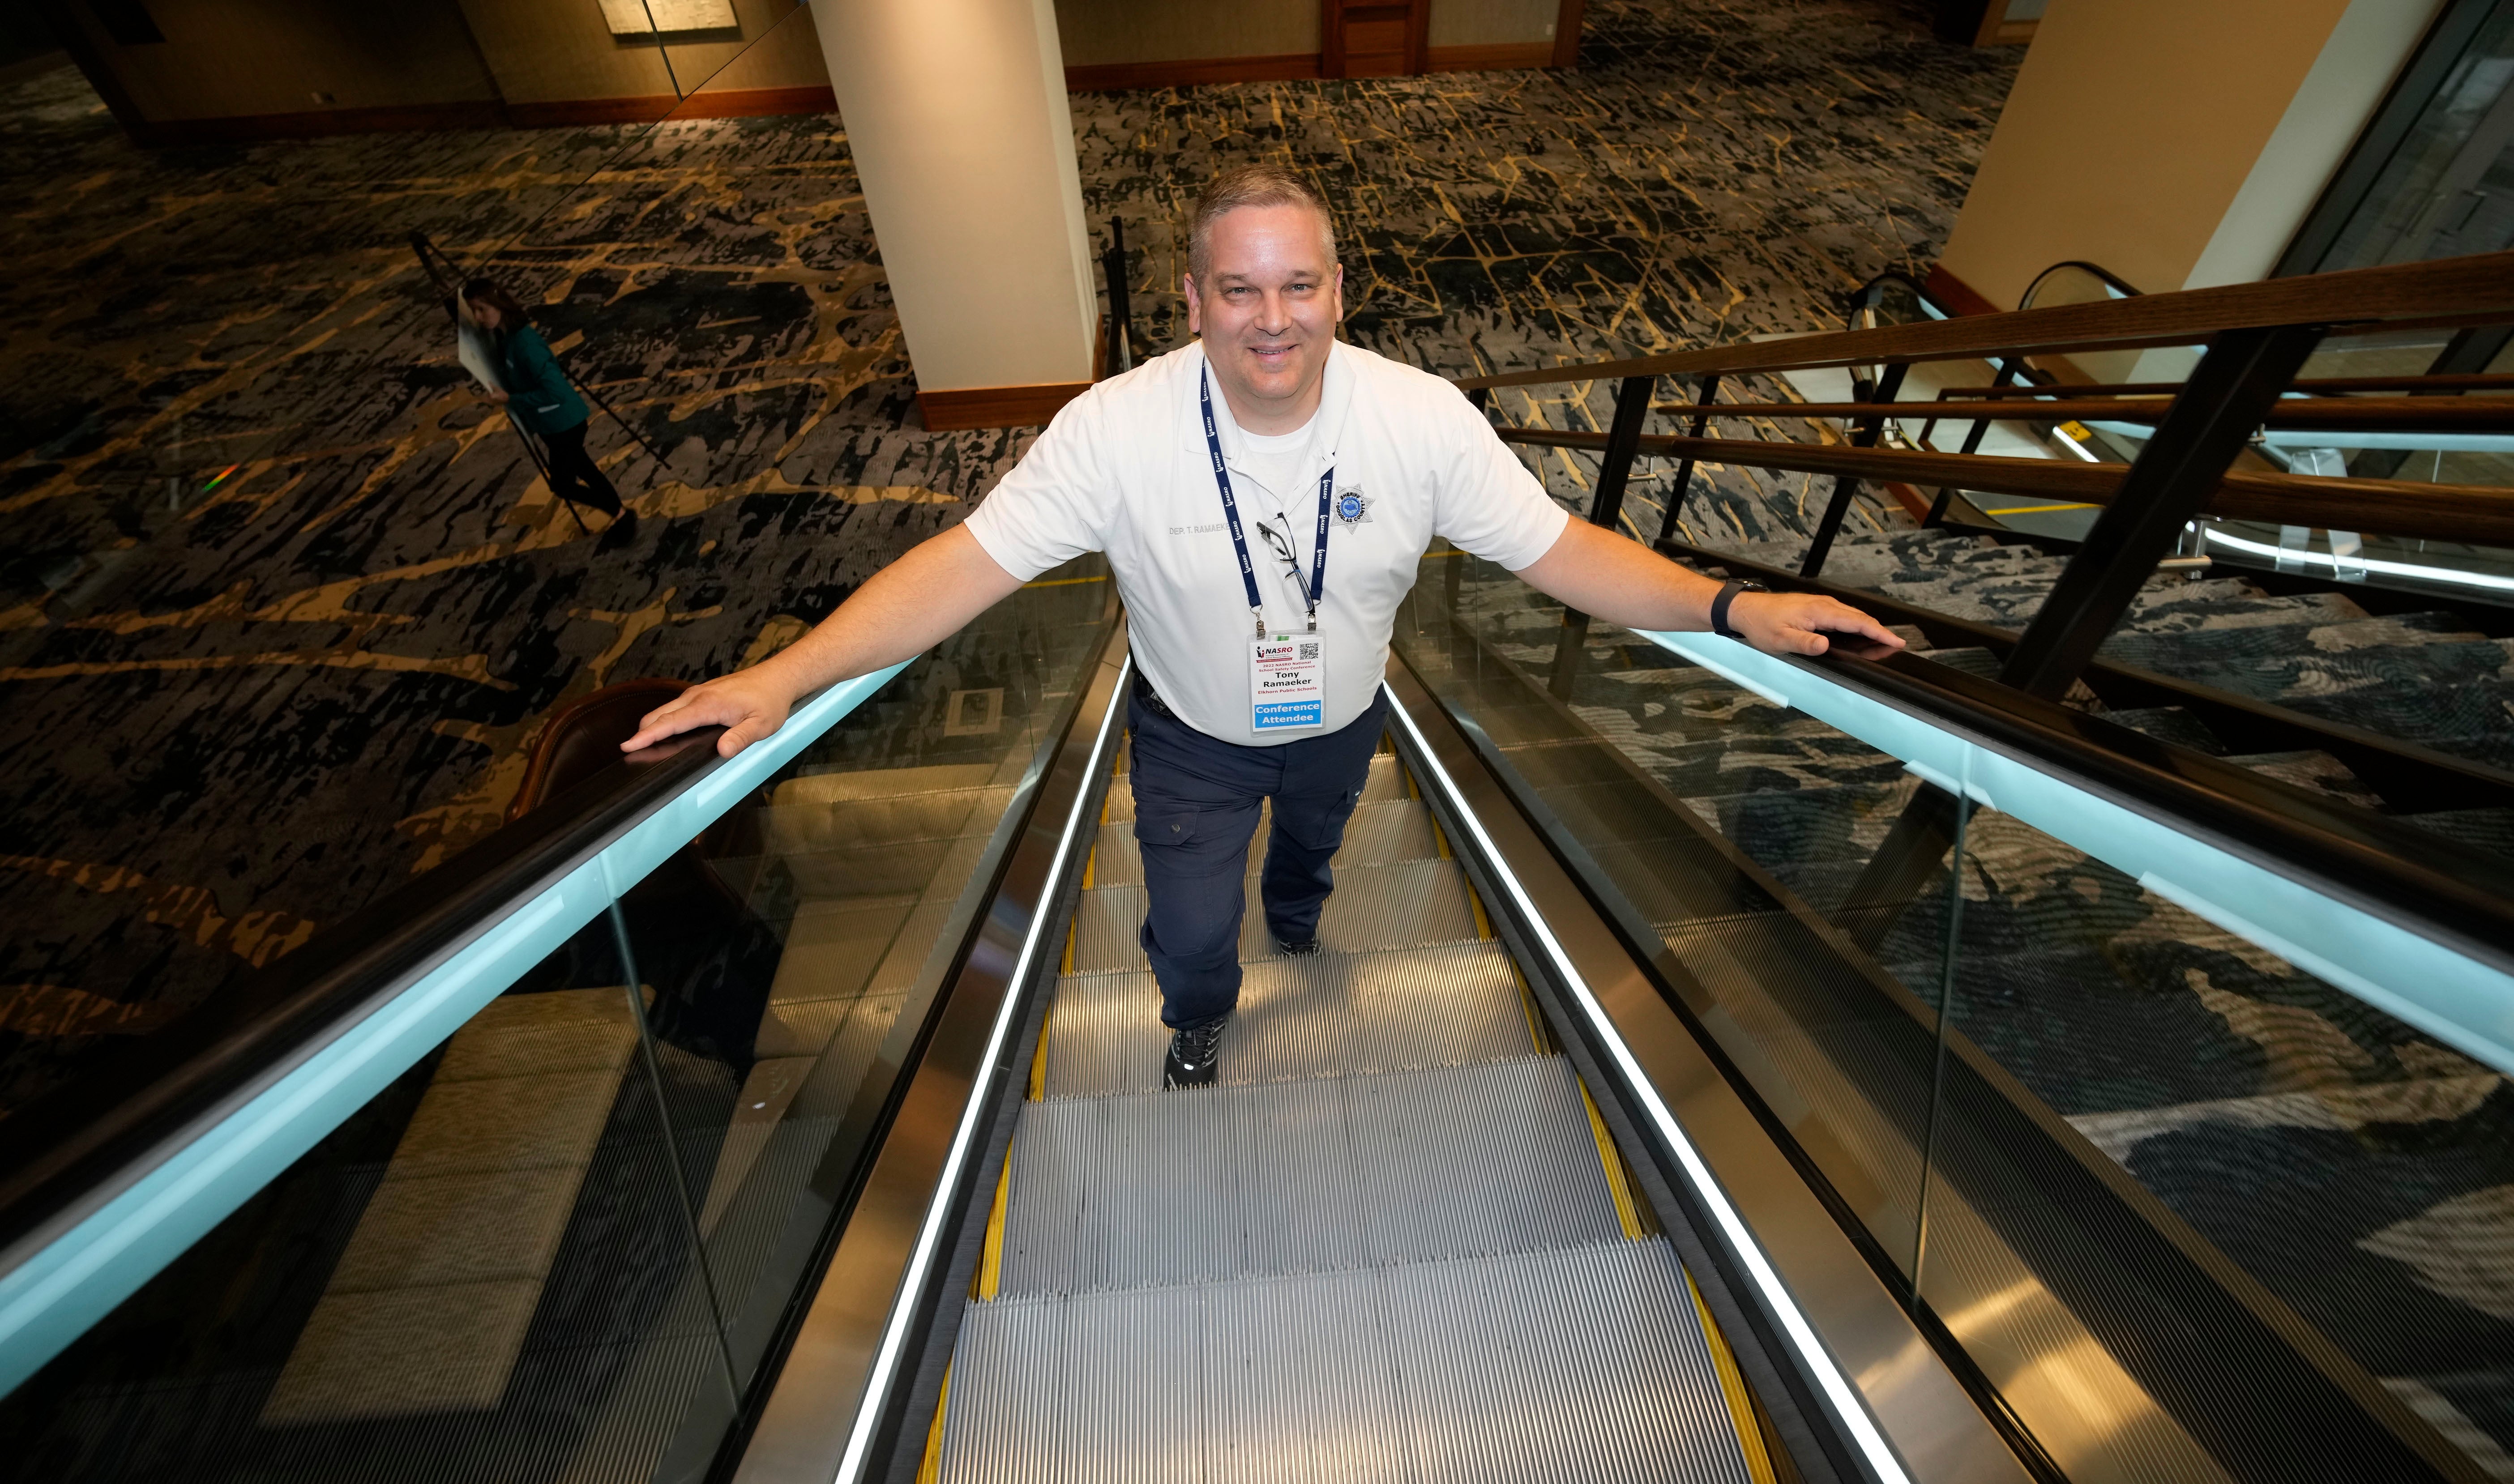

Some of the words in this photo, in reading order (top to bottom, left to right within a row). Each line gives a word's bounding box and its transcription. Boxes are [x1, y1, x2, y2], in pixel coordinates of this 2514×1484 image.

[1336, 505, 1352, 523] DOUGLAS
[1354, 503, 1365, 521] COUNTY
[1169, 527, 1185, 535] DEP.
[1194, 523, 1230, 533] RAMAEKE
[1264, 679, 1312, 687] Ramaeker
[1256, 704, 1320, 713] Conference
[1262, 714, 1313, 724] Attendee
